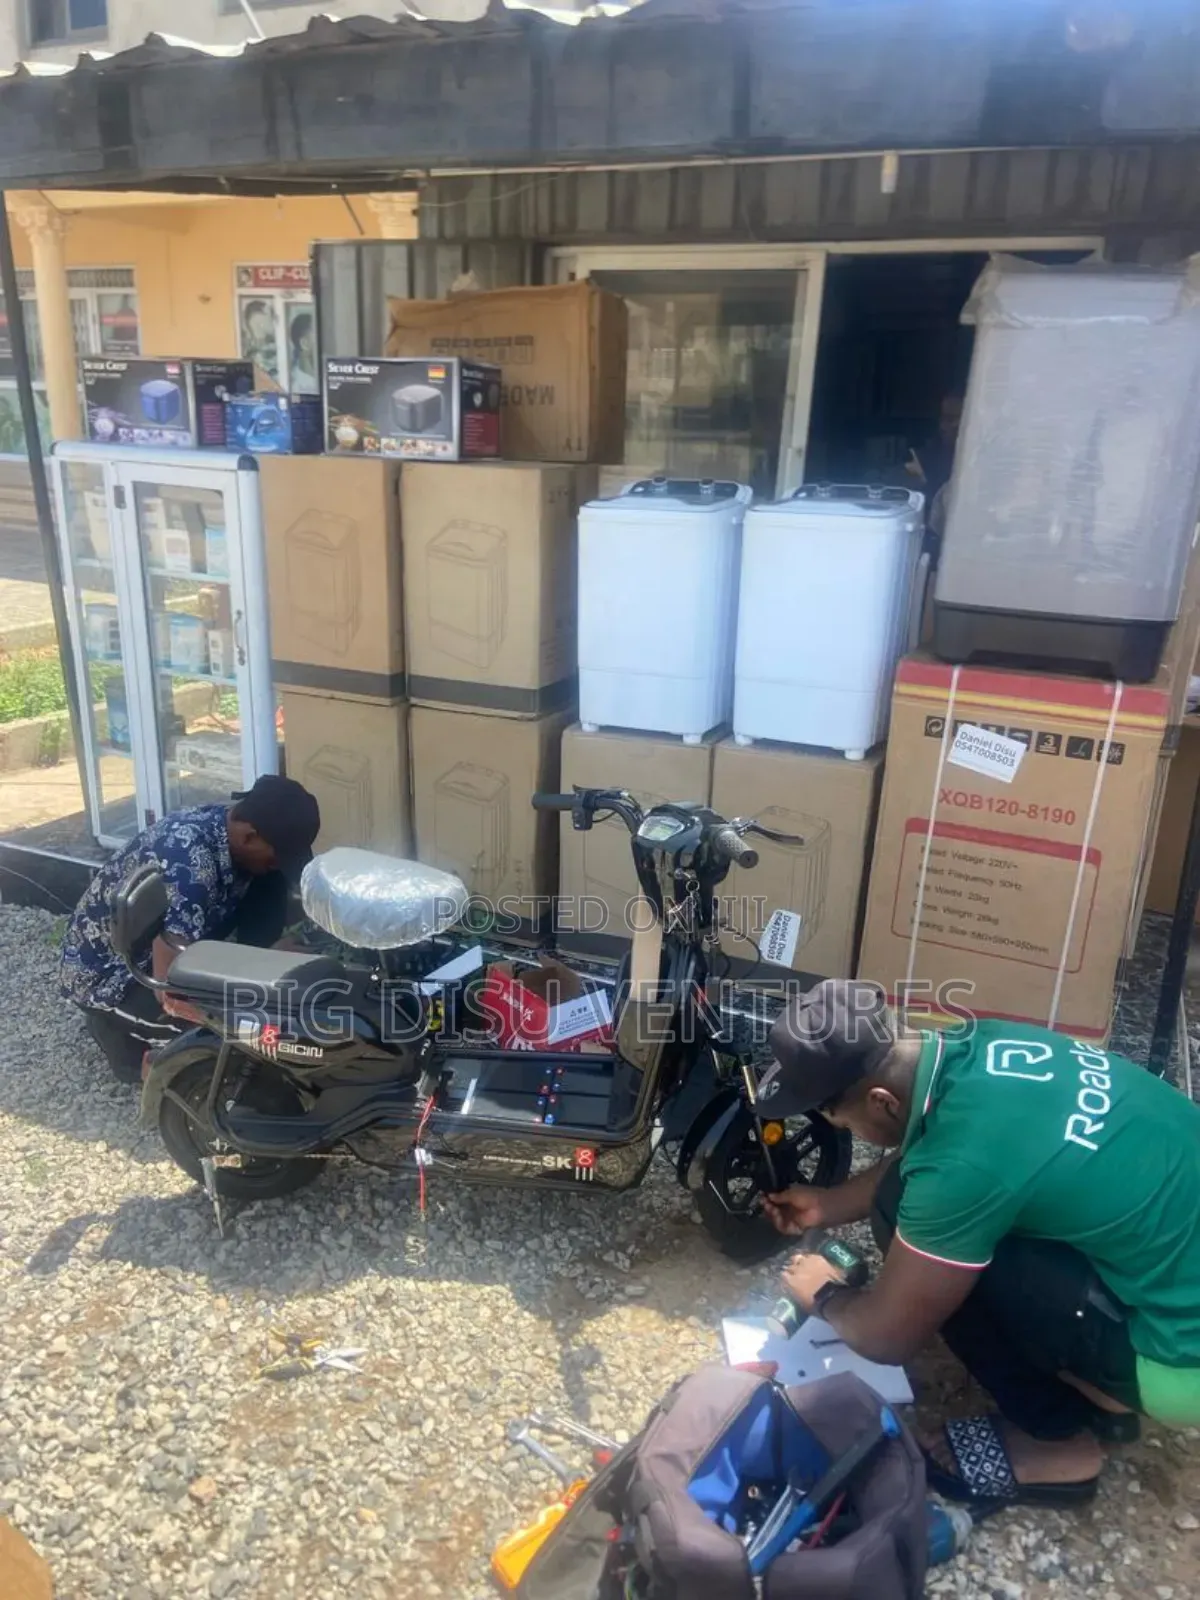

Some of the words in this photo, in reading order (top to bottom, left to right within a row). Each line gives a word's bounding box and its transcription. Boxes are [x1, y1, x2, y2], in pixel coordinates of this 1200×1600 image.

[954, 740, 1015, 767] 0547008503
[959, 731, 994, 748] Daniel
[993, 741, 1017, 758] Disu
